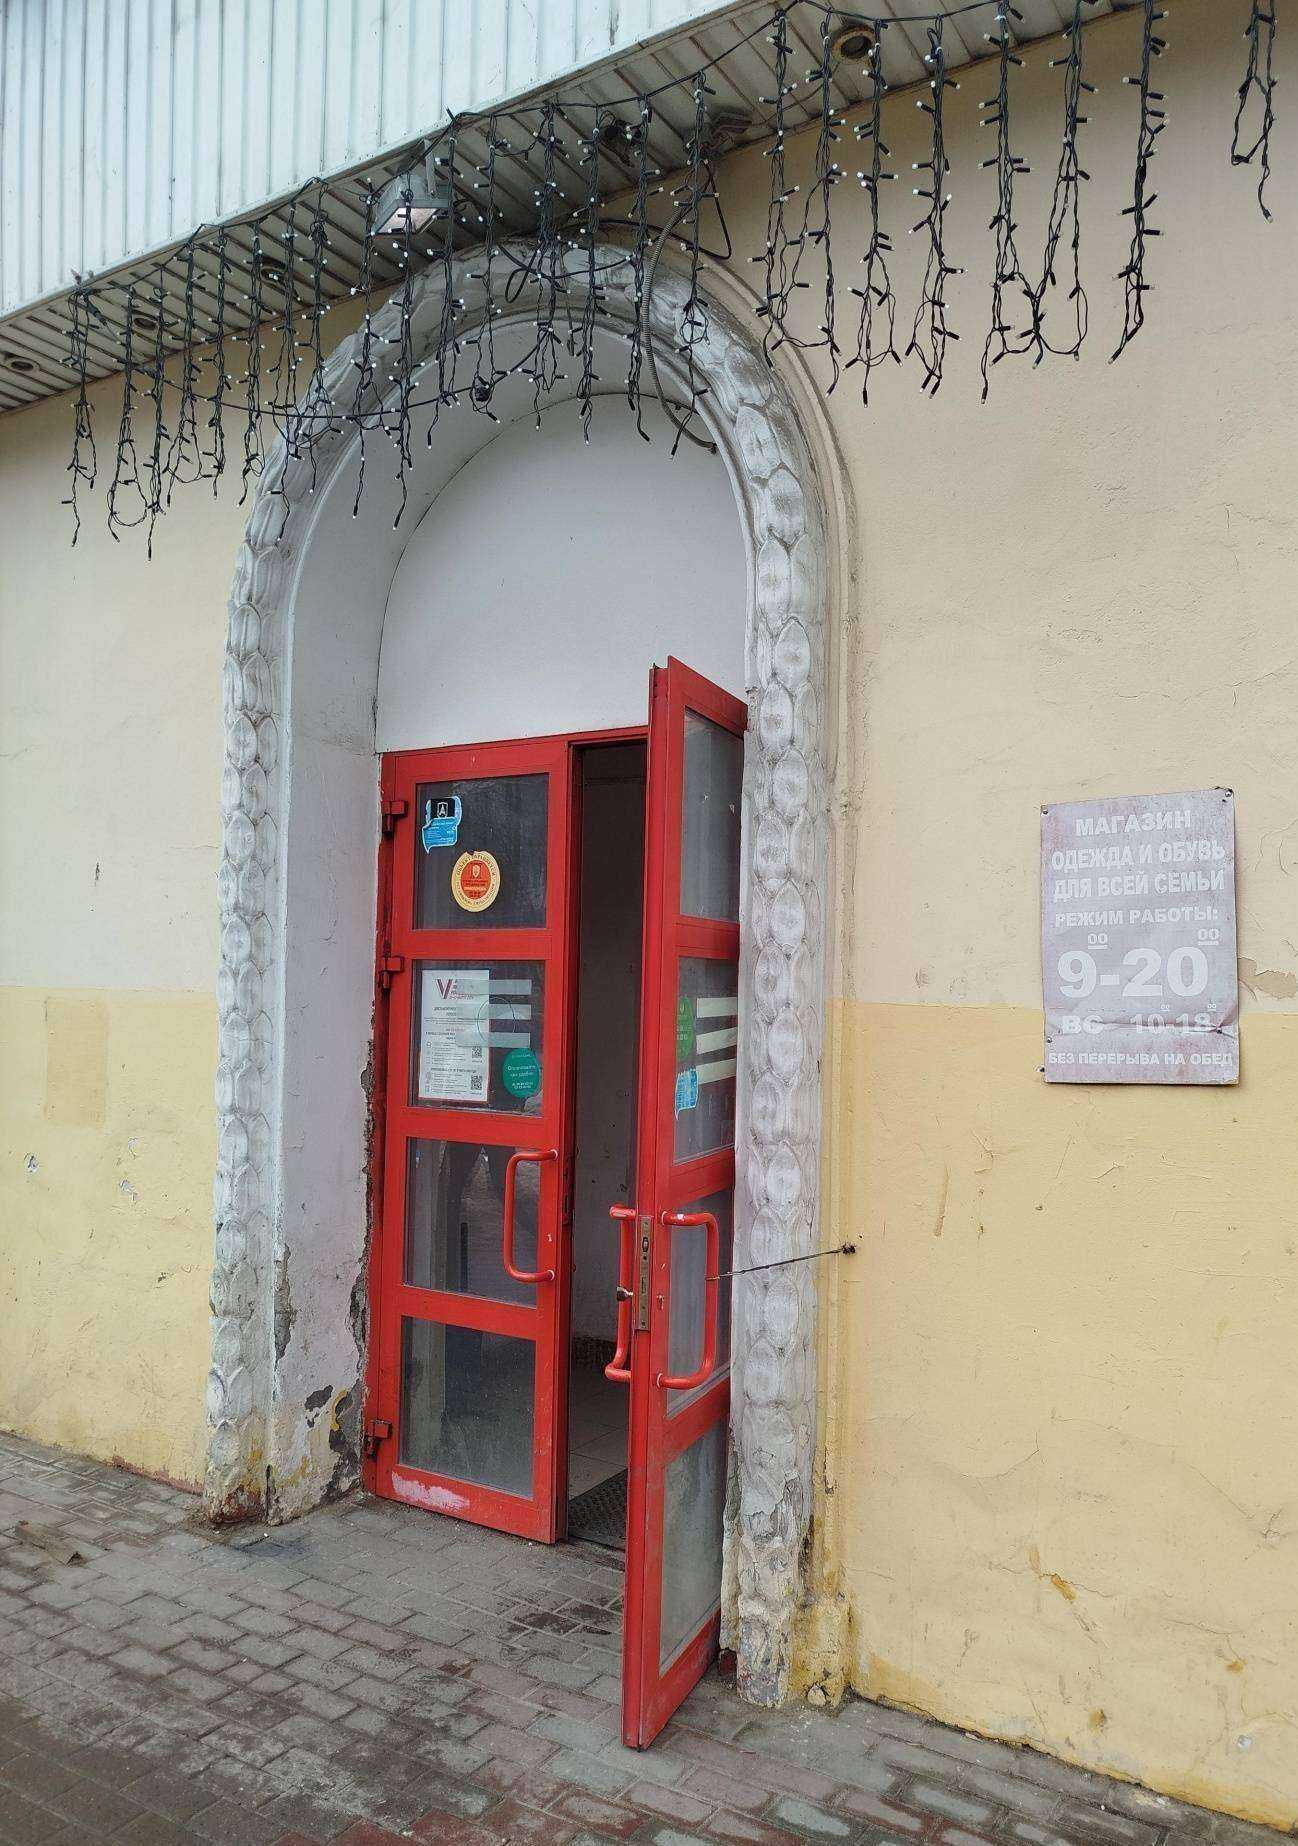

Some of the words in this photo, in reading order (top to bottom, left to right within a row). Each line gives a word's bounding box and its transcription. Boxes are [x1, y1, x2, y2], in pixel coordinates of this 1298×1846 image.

[1076, 809, 1191, 837] МАГАЗИН
[1051, 847, 1134, 873] ОДЕЖДА
[1139, 847, 1153, 865] И
[1159, 838, 1226, 863] ОБУВЬ
[1054, 878, 1092, 903] ДЛЯ
[1098, 871, 1149, 898] ВСЕЙ
[1154, 869, 1225, 893] СЕМЬИ
[1055, 911, 1124, 928] РЕЖИМ
[1130, 906, 1218, 924] РАБОТЫ:
[1087, 933, 1108, 946] 00
[1198, 928, 1220, 942] 00
[1057, 946, 1209, 999] 9-20
[1048, 1052, 1075, 1066] БЕЗ
[1078, 1052, 1159, 1067] ПЕРЕРЫВА
[1164, 1053, 1187, 1066] НА
[1190, 1052, 1233, 1069] ОБЕД
